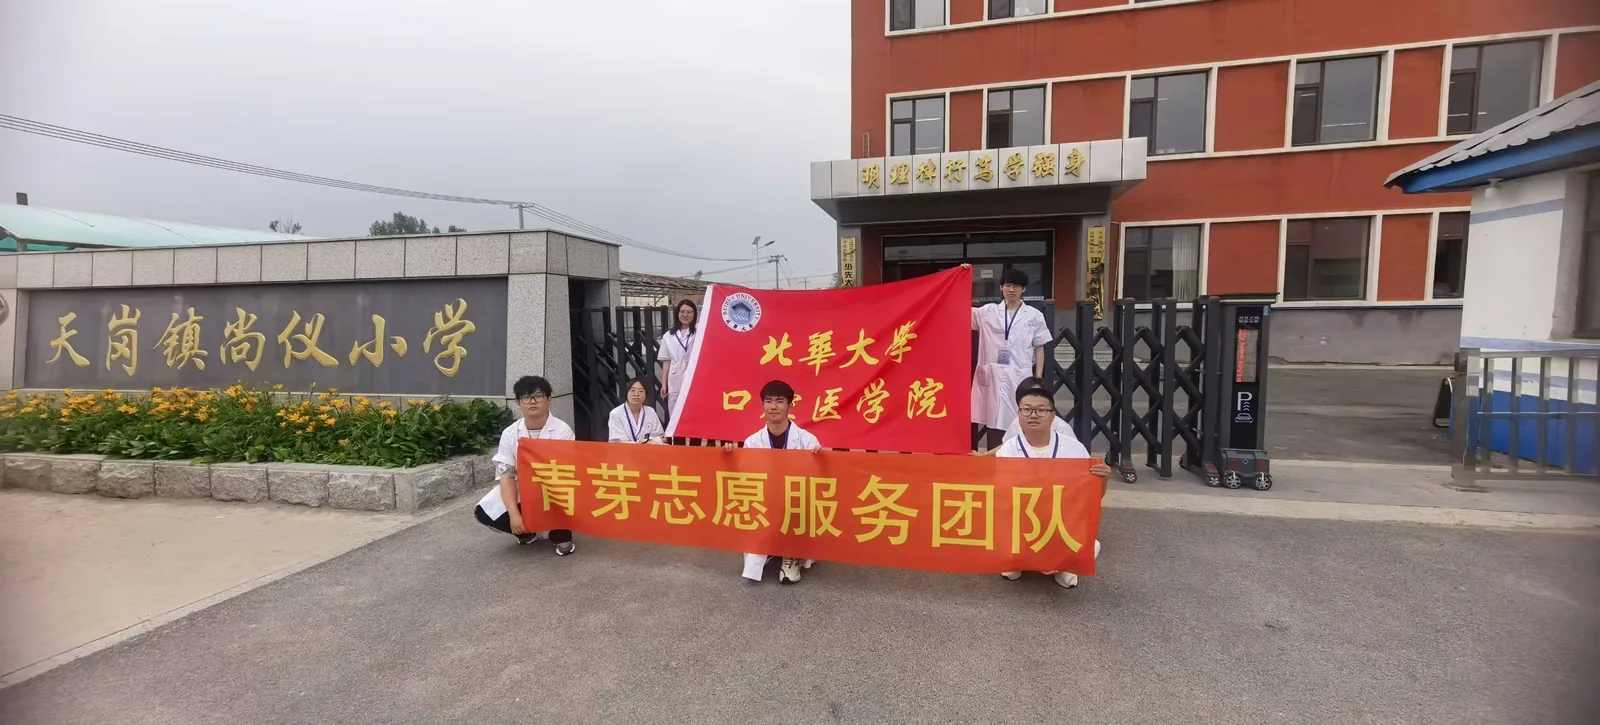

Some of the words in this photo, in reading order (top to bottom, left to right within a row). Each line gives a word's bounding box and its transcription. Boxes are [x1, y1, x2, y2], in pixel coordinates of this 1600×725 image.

[723, 296, 735, 315] BEIHUA
[736, 293, 760, 320] UNIVERSITY
[46, 298, 476, 378] 天岗镇尚仪小学
[722, 377, 948, 424] 口医学院
[1237, 391, 1253, 411] P
[530, 459, 1083, 554] 青芽志愿服务团队
